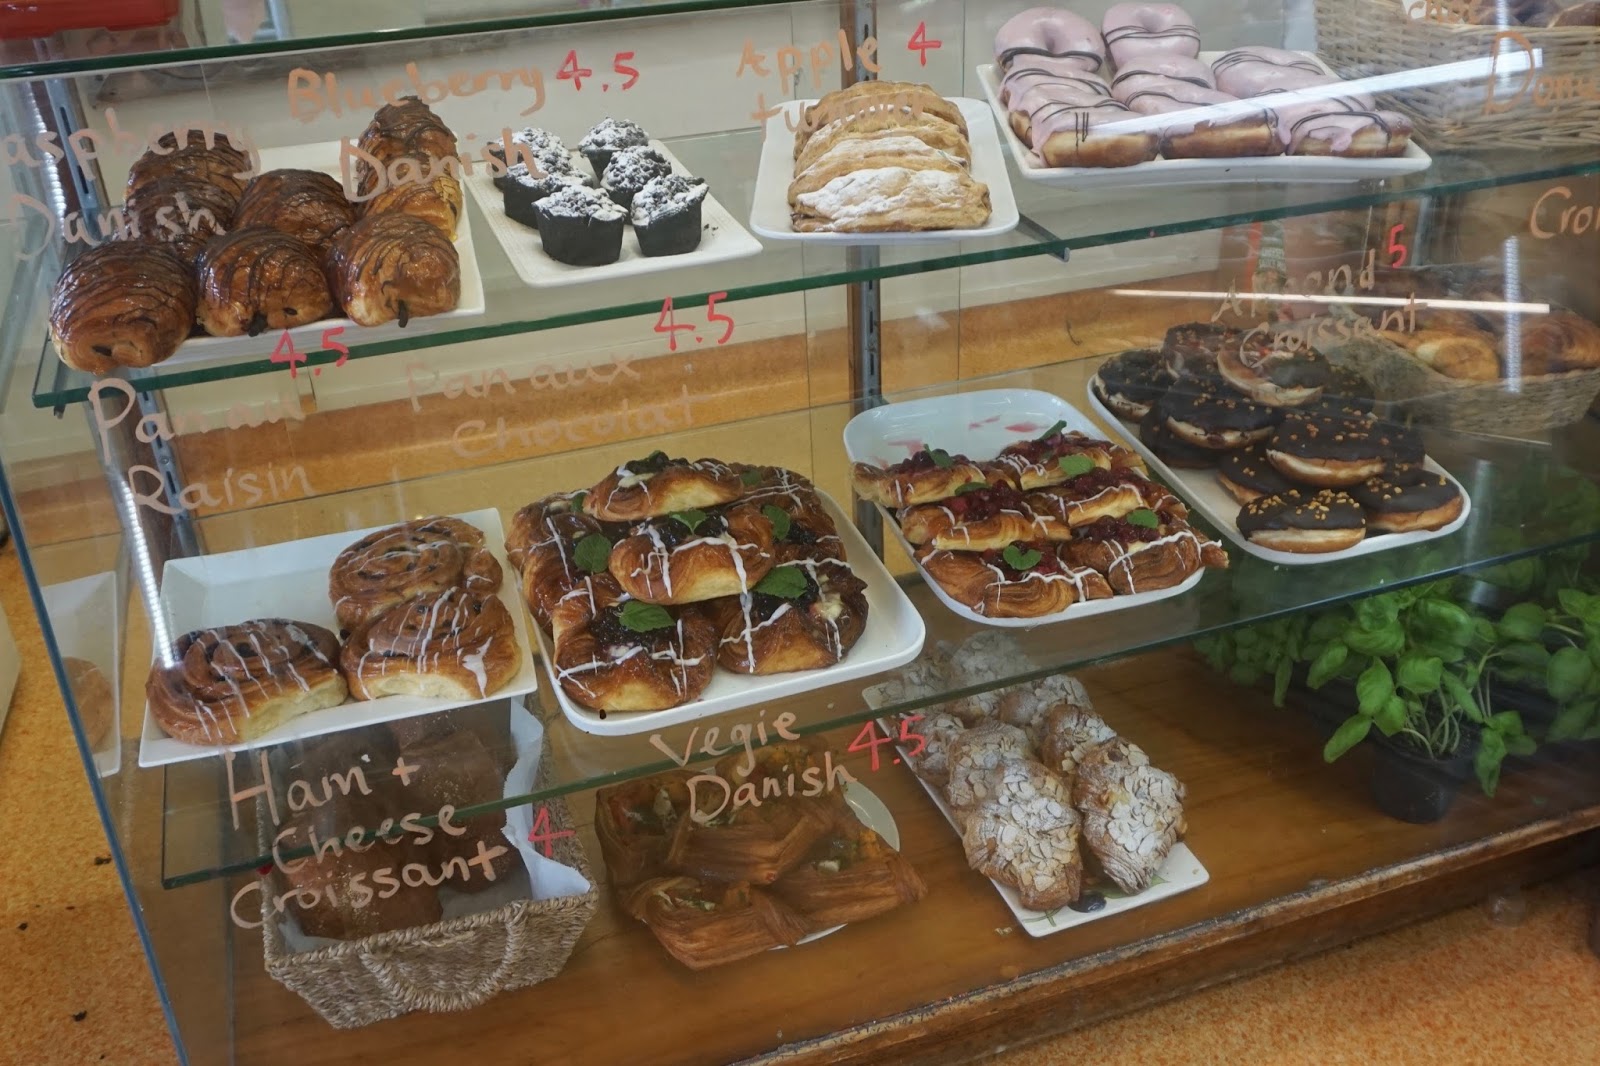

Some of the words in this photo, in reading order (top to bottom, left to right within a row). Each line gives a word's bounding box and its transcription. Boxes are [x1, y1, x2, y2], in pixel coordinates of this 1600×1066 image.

[288, 62, 546, 124] Blueberry
[556, 50, 640, 92] 4.5
[735, 28, 883, 96] Apple
[907, 21, 942, 67] 4
[339, 127, 548, 202] Danish
[7, 192, 227, 260] Danish
[1388, 223, 1407, 268] 5
[270, 326, 349, 379] 4.5
[529, 353, 641, 392] aux
[654, 292, 735, 351] 4.5
[1240, 291, 1428, 369] Croissant
[450, 384, 711, 458] Chocolat
[128, 461, 318, 515] Raisin
[650, 710, 800, 777] Vegie
[686, 751, 857, 823] Danish
[847, 715, 926, 772] 4.5
[222, 750, 373, 832] Ham
[230, 841, 508, 929] Croissant
[528, 806, 575, 857] 4
[272, 804, 467, 875] Cheese
